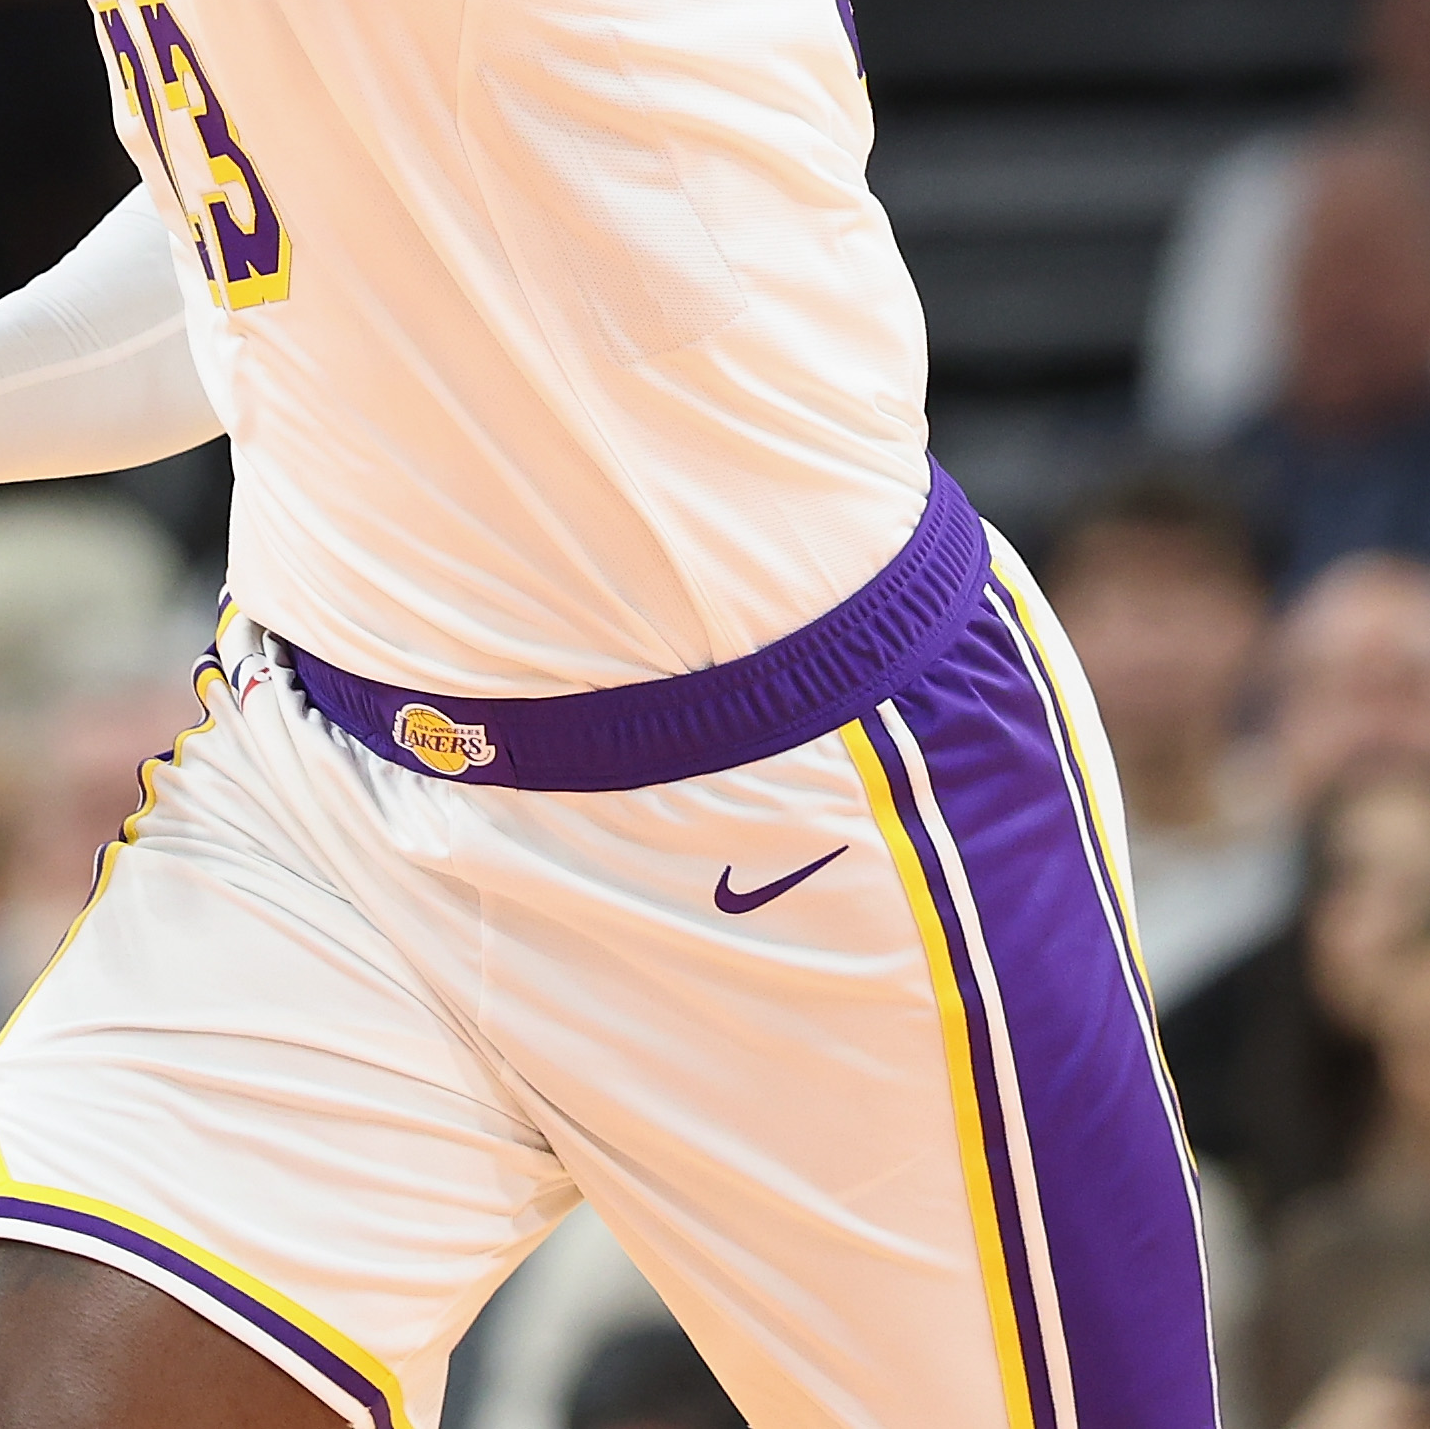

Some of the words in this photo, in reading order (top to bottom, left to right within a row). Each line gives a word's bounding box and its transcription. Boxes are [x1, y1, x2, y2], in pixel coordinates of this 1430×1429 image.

[401, 717, 491, 762] LAKERS
[413, 722, 429, 732] LOS
[430, 726, 481, 736] ANGELES
